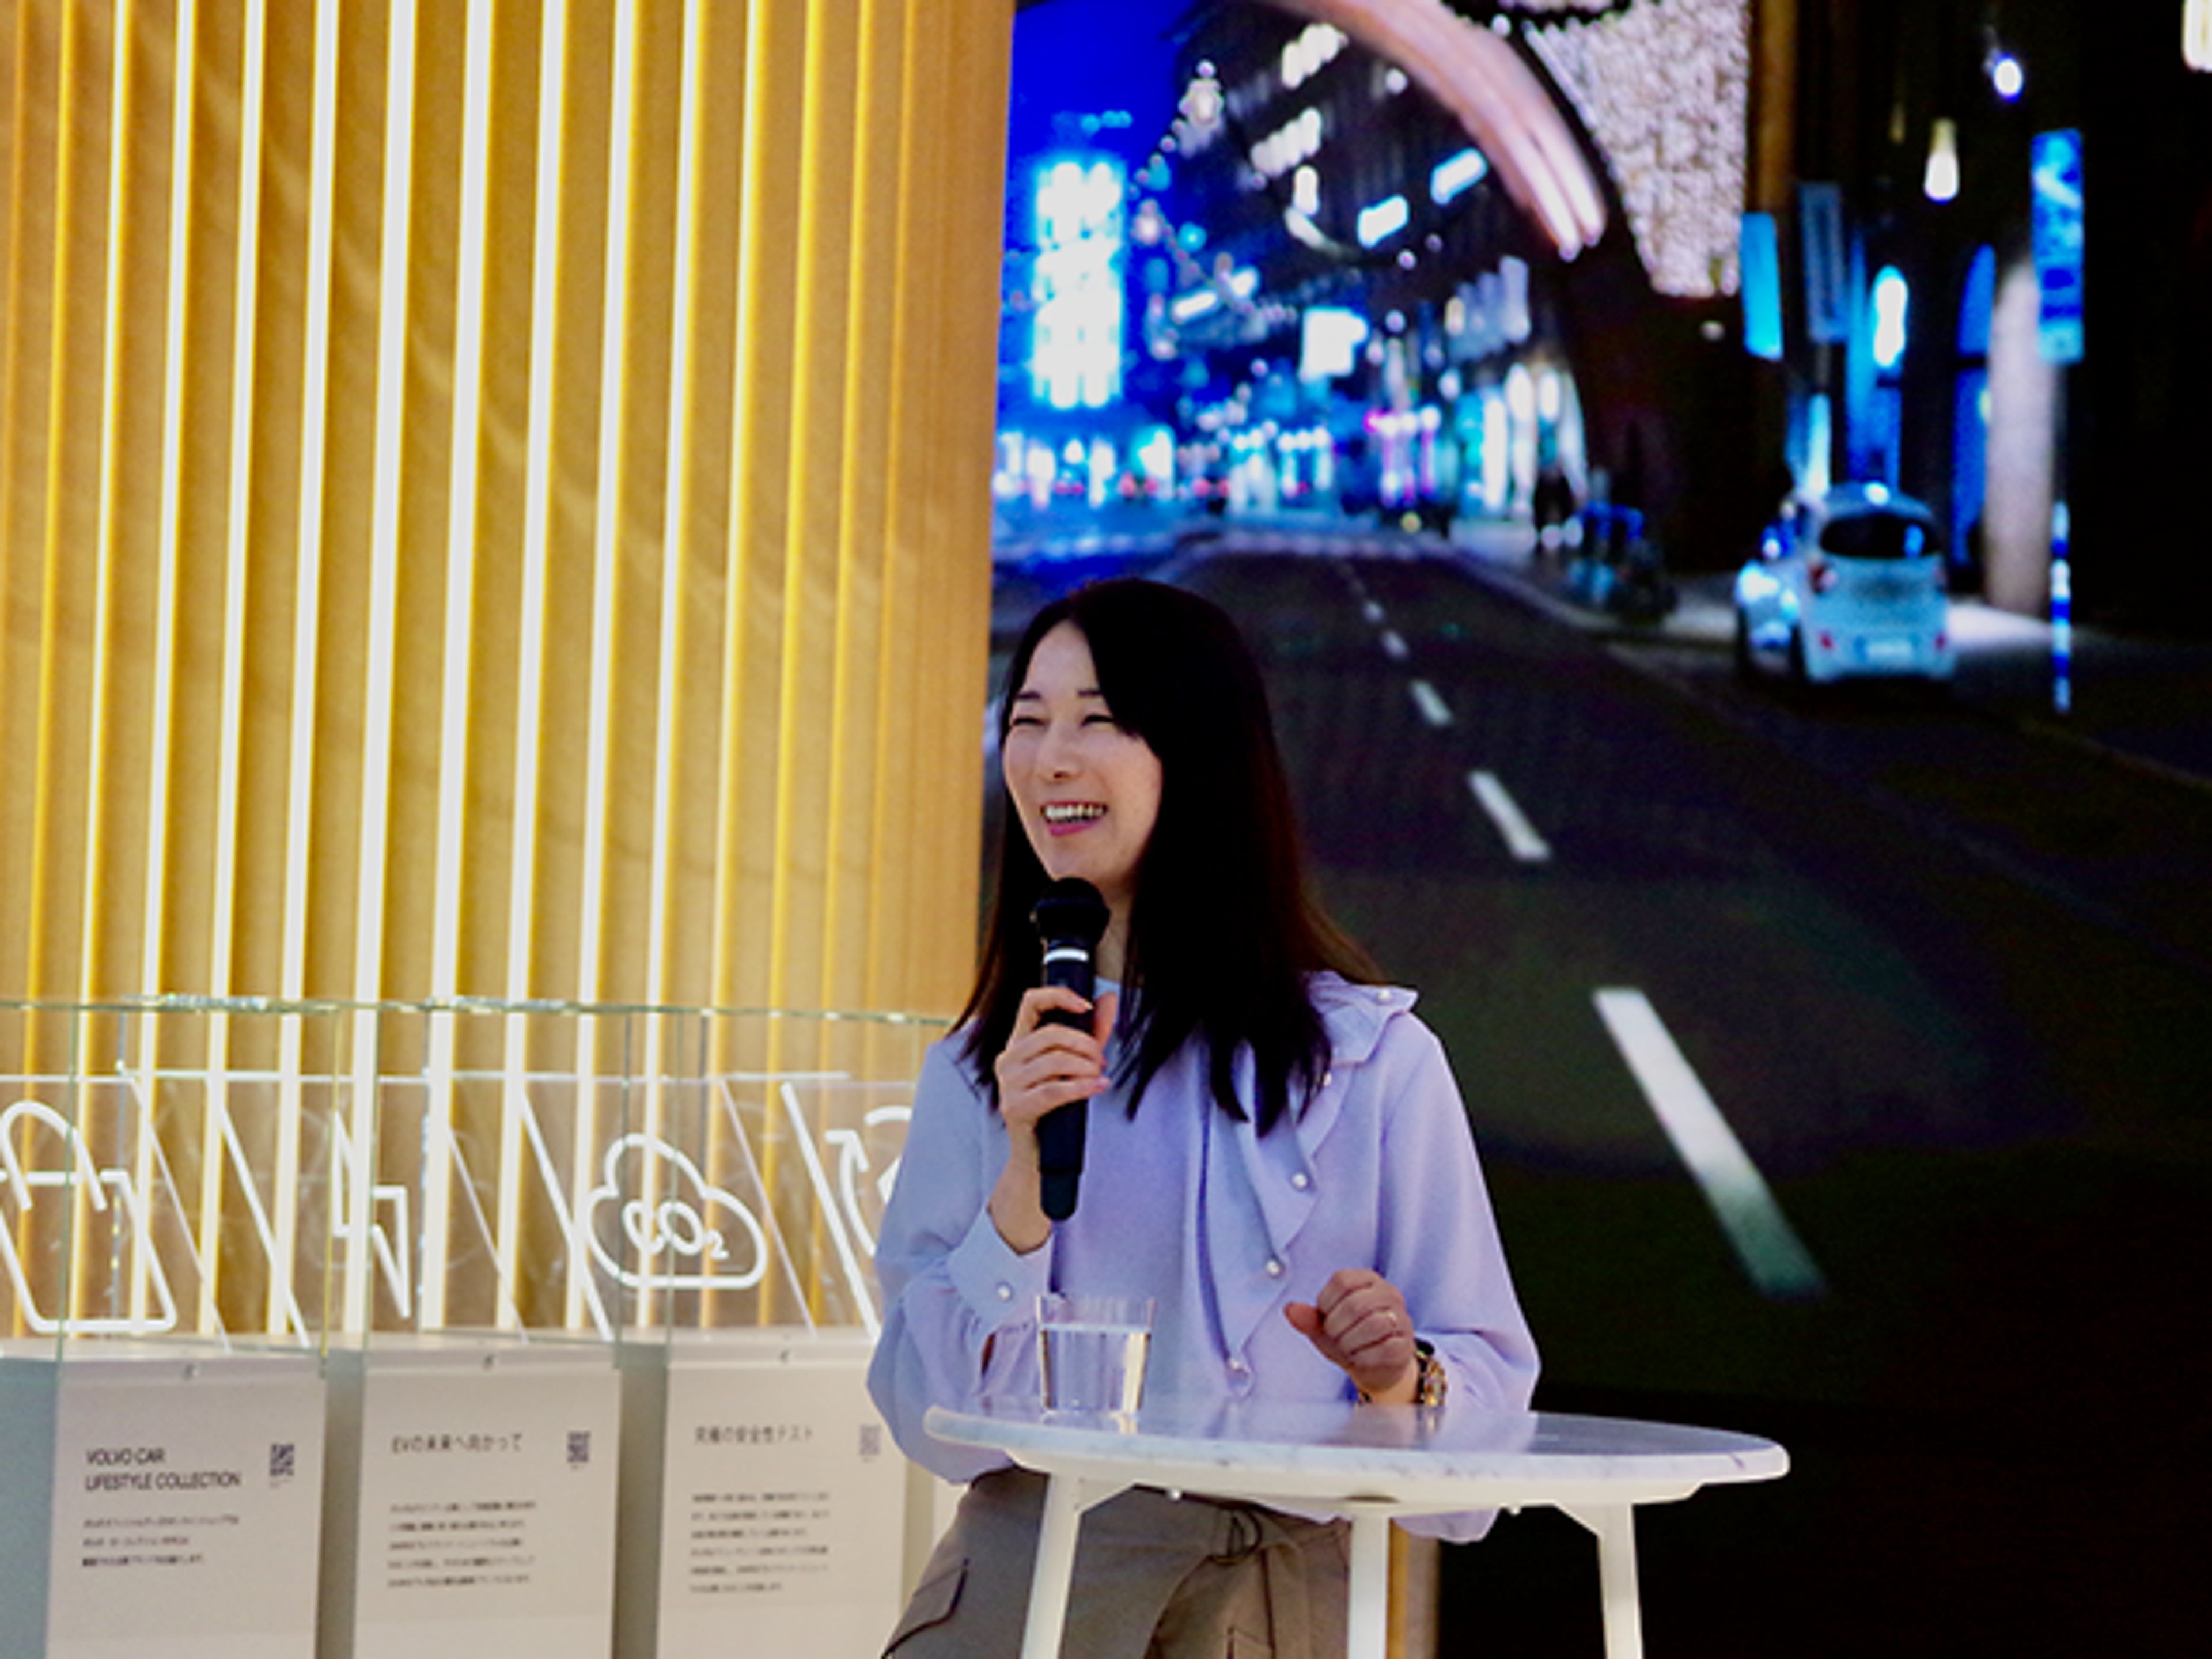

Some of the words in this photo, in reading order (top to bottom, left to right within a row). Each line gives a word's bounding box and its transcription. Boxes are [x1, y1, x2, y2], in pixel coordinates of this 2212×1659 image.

[86, 1449, 131, 1465] VOLVO
[134, 1448, 165, 1464] CAR
[86, 1472, 152, 1491] LIFESTYLE
[156, 1471, 241, 1490] COLLECTION
